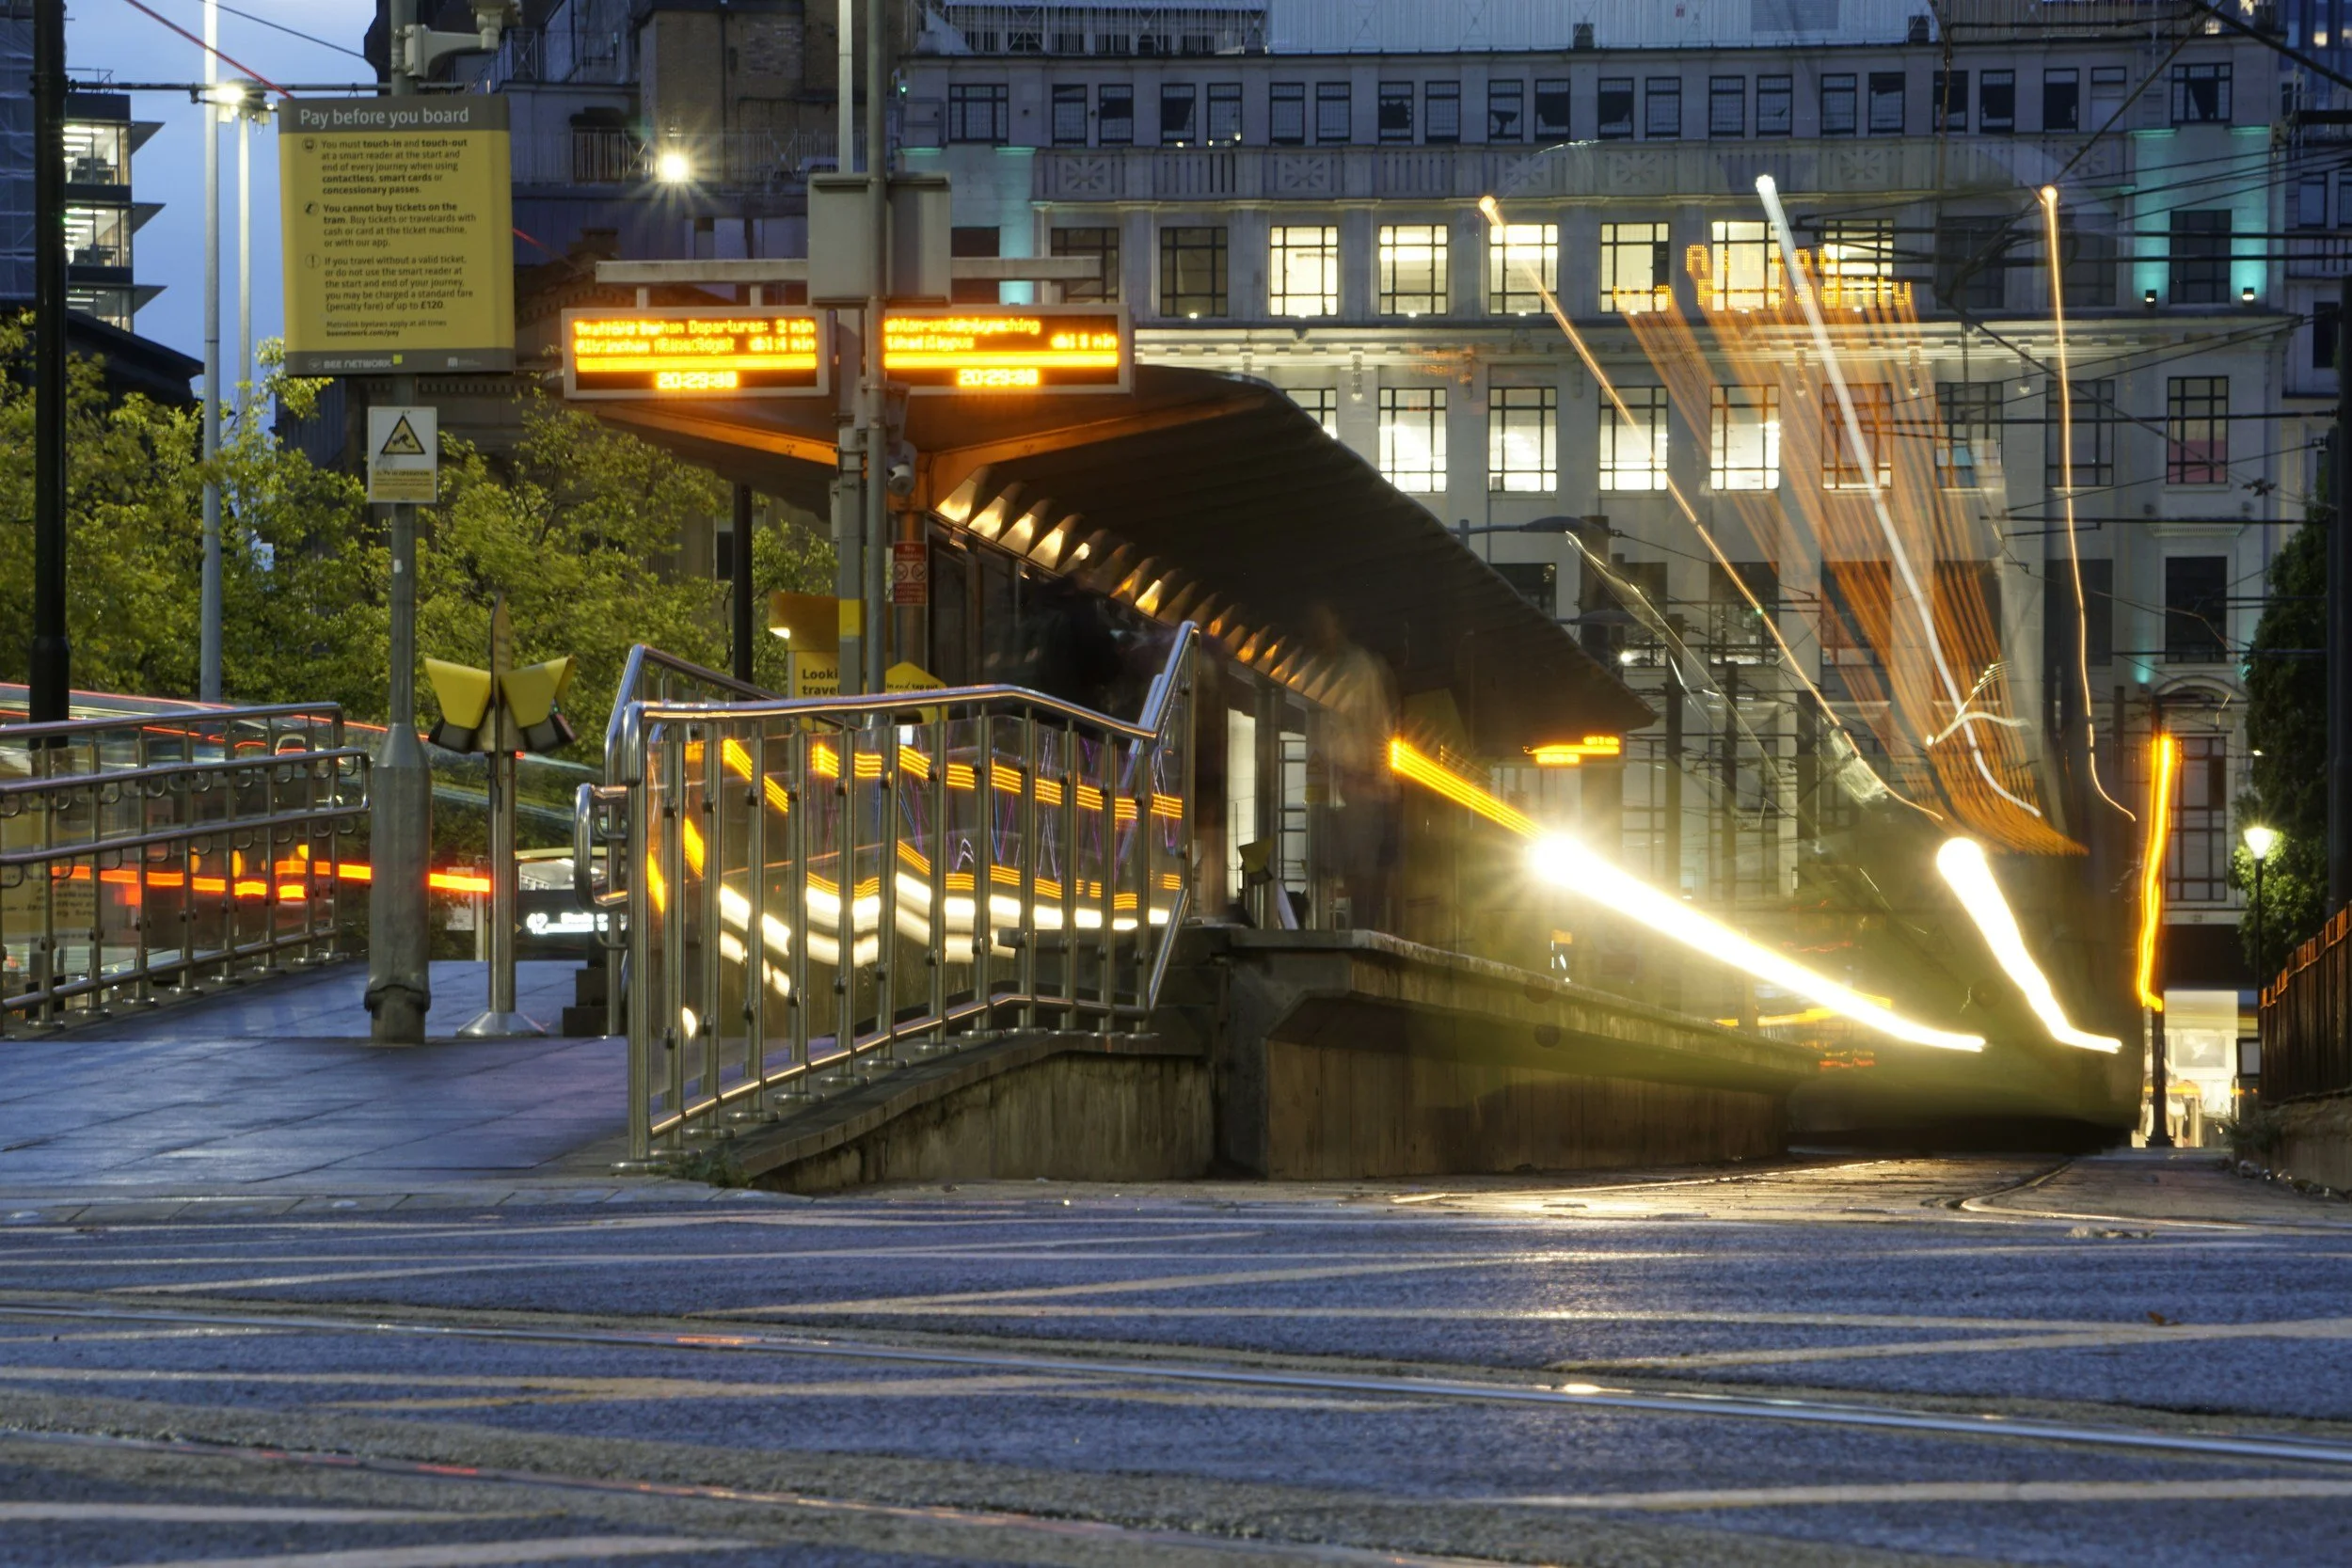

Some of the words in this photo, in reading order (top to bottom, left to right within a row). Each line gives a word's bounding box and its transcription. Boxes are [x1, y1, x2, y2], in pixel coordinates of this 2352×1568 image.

[300, 109, 328, 129] Pay
[333, 108, 385, 124] before
[389, 111, 418, 128] you
[423, 107, 469, 123] board
[404, 139, 419, 148] and
[340, 151, 363, 160] smart
[366, 150, 392, 159] reader
[444, 150, 459, 158] and
[341, 163, 348, 171] of
[351, 165, 373, 173] every
[376, 163, 407, 172] journey
[436, 162, 458, 171] using
[323, 174, 376, 183] contactless,
[323, 186, 386, 196] concessionary
[389, 185, 421, 195] passes.
[324, 204, 340, 213] You
[377, 204, 392, 214] buy
[350, 215, 366, 224] Buy
[369, 214, 396, 223] tickets
[357, 227, 373, 235] card
[429, 226, 467, 234] machine,
[373, 239, 390, 248] app.
[333, 259, 348, 267] you
[440, 256, 466, 264] ticket,
[410, 280, 428, 289] your
[431, 278, 464, 289] journey,
[326, 292, 340, 301] you
[343, 292, 360, 300] may
[376, 290, 408, 300] charged
[326, 303, 361, 313] (penalty
[364, 302, 384, 310] fare)
[324, 359, 342, 369] BEE
[343, 358, 391, 369] NETWORK
